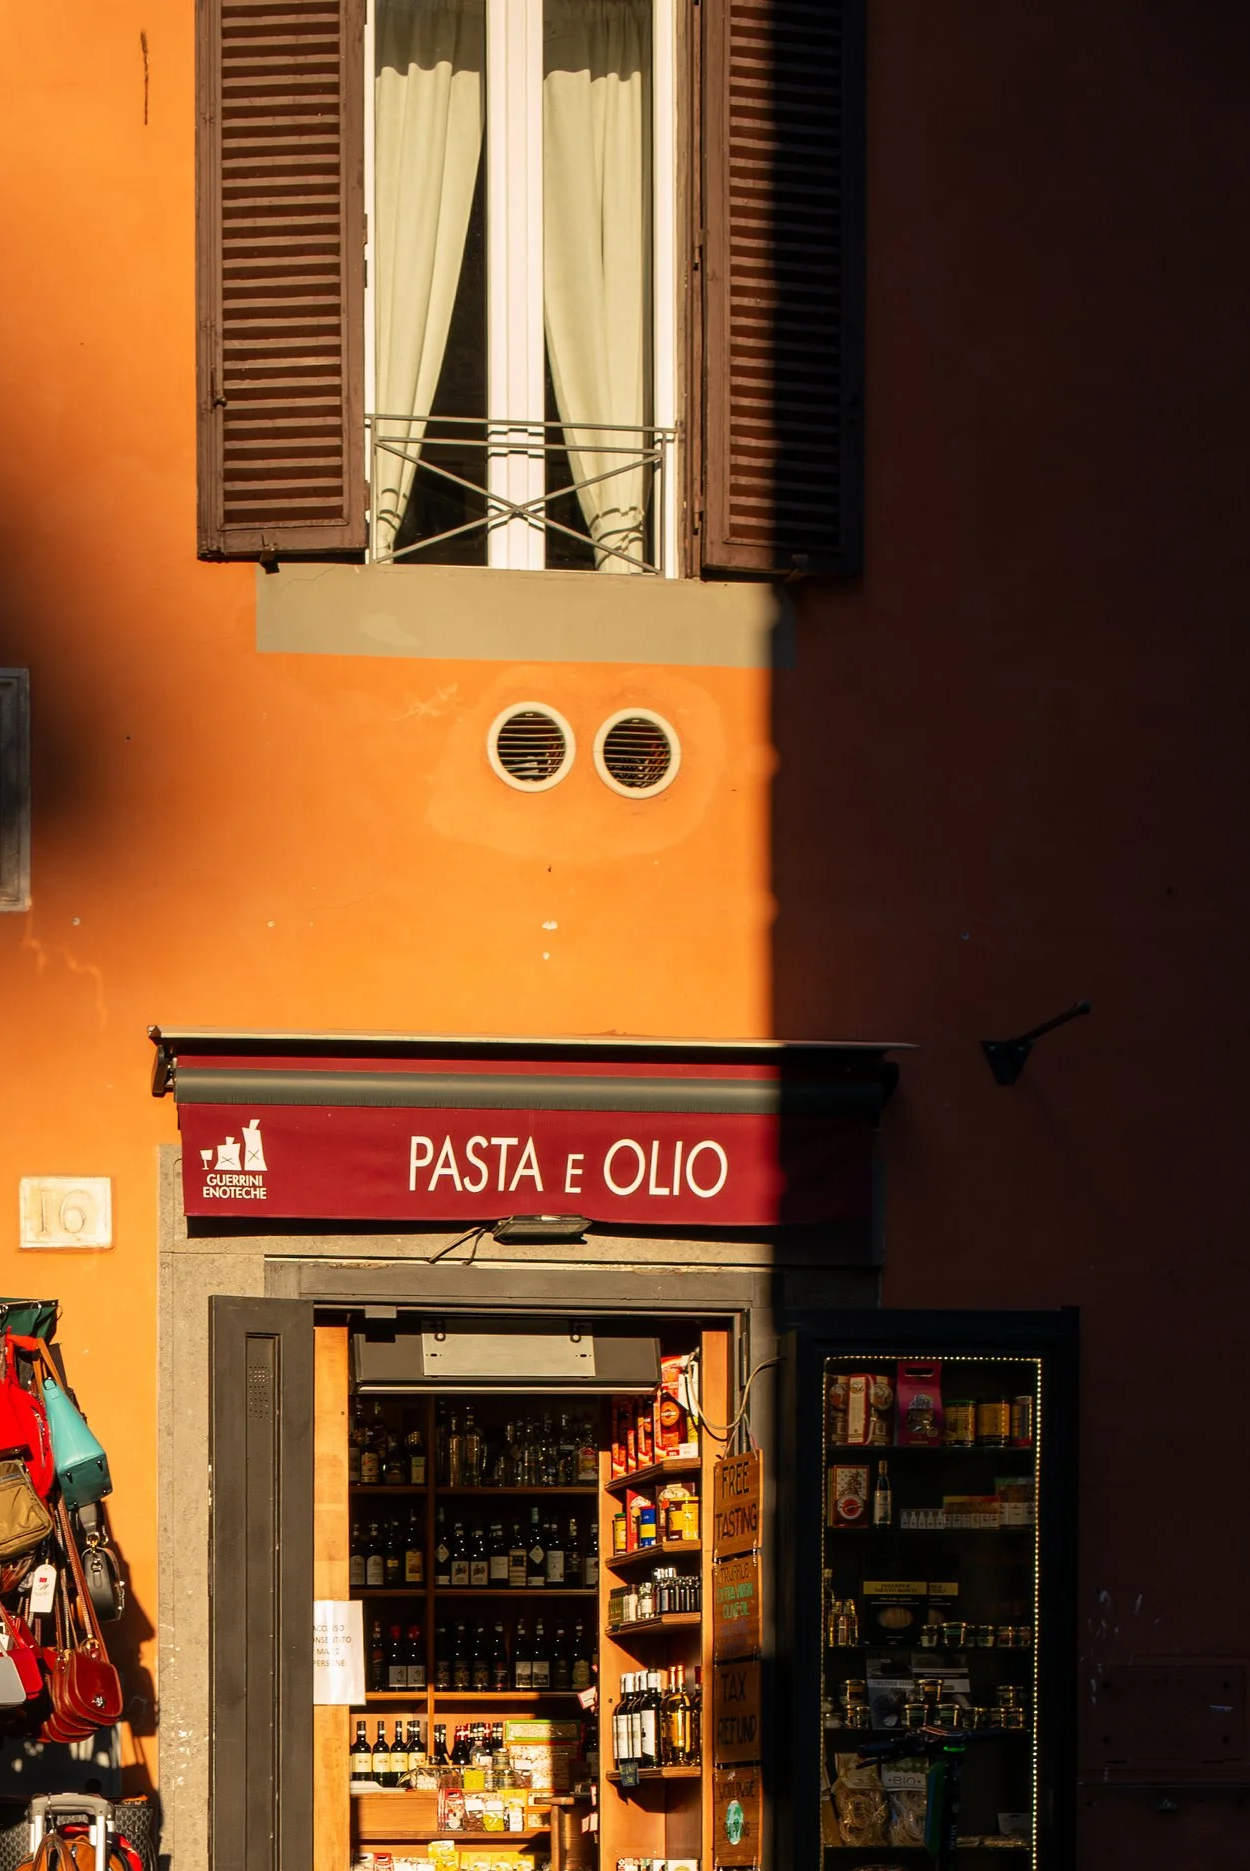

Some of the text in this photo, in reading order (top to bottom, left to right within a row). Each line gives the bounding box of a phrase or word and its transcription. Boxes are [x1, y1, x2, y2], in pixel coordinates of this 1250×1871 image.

[206, 1173, 264, 1187] GUERRINI
[409, 1136, 729, 1199] PASTA E OLIO
[202, 1186, 267, 1200] ENOTECHE
[38, 1189, 96, 1235] 16
[722, 1461, 750, 1498] FREE
[715, 1503, 757, 1540] TASTING
[721, 1672, 747, 1703] TAX
[718, 1715, 757, 1745] REFUND
[893, 1776, 916, 1785] BIO
